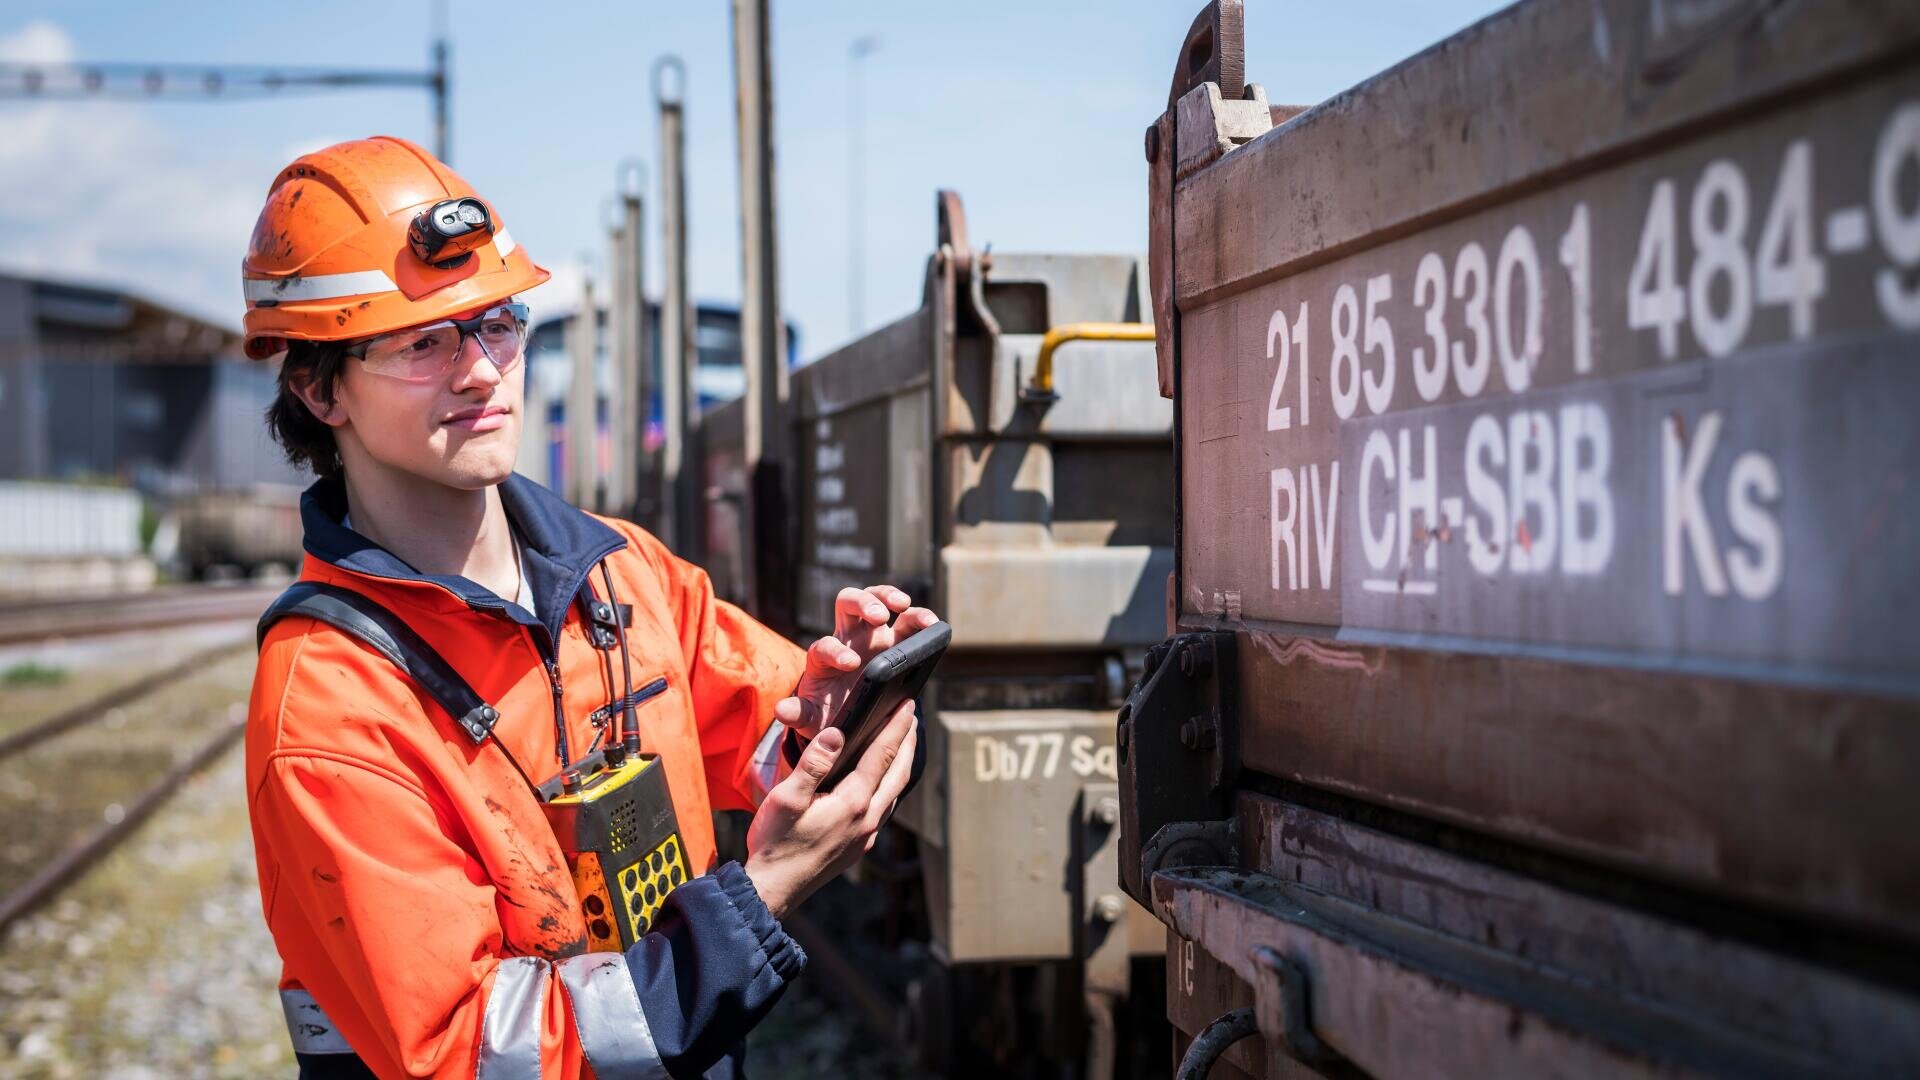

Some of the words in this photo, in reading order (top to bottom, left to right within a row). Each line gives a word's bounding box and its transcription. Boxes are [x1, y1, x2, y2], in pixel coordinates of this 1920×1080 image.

[1266, 300, 1310, 432] 21
[1330, 270, 1396, 421] 85
[1270, 461, 1340, 591] RIV
[1358, 402, 1616, 577] CH-SBB
[1661, 411, 1784, 601] Ks
